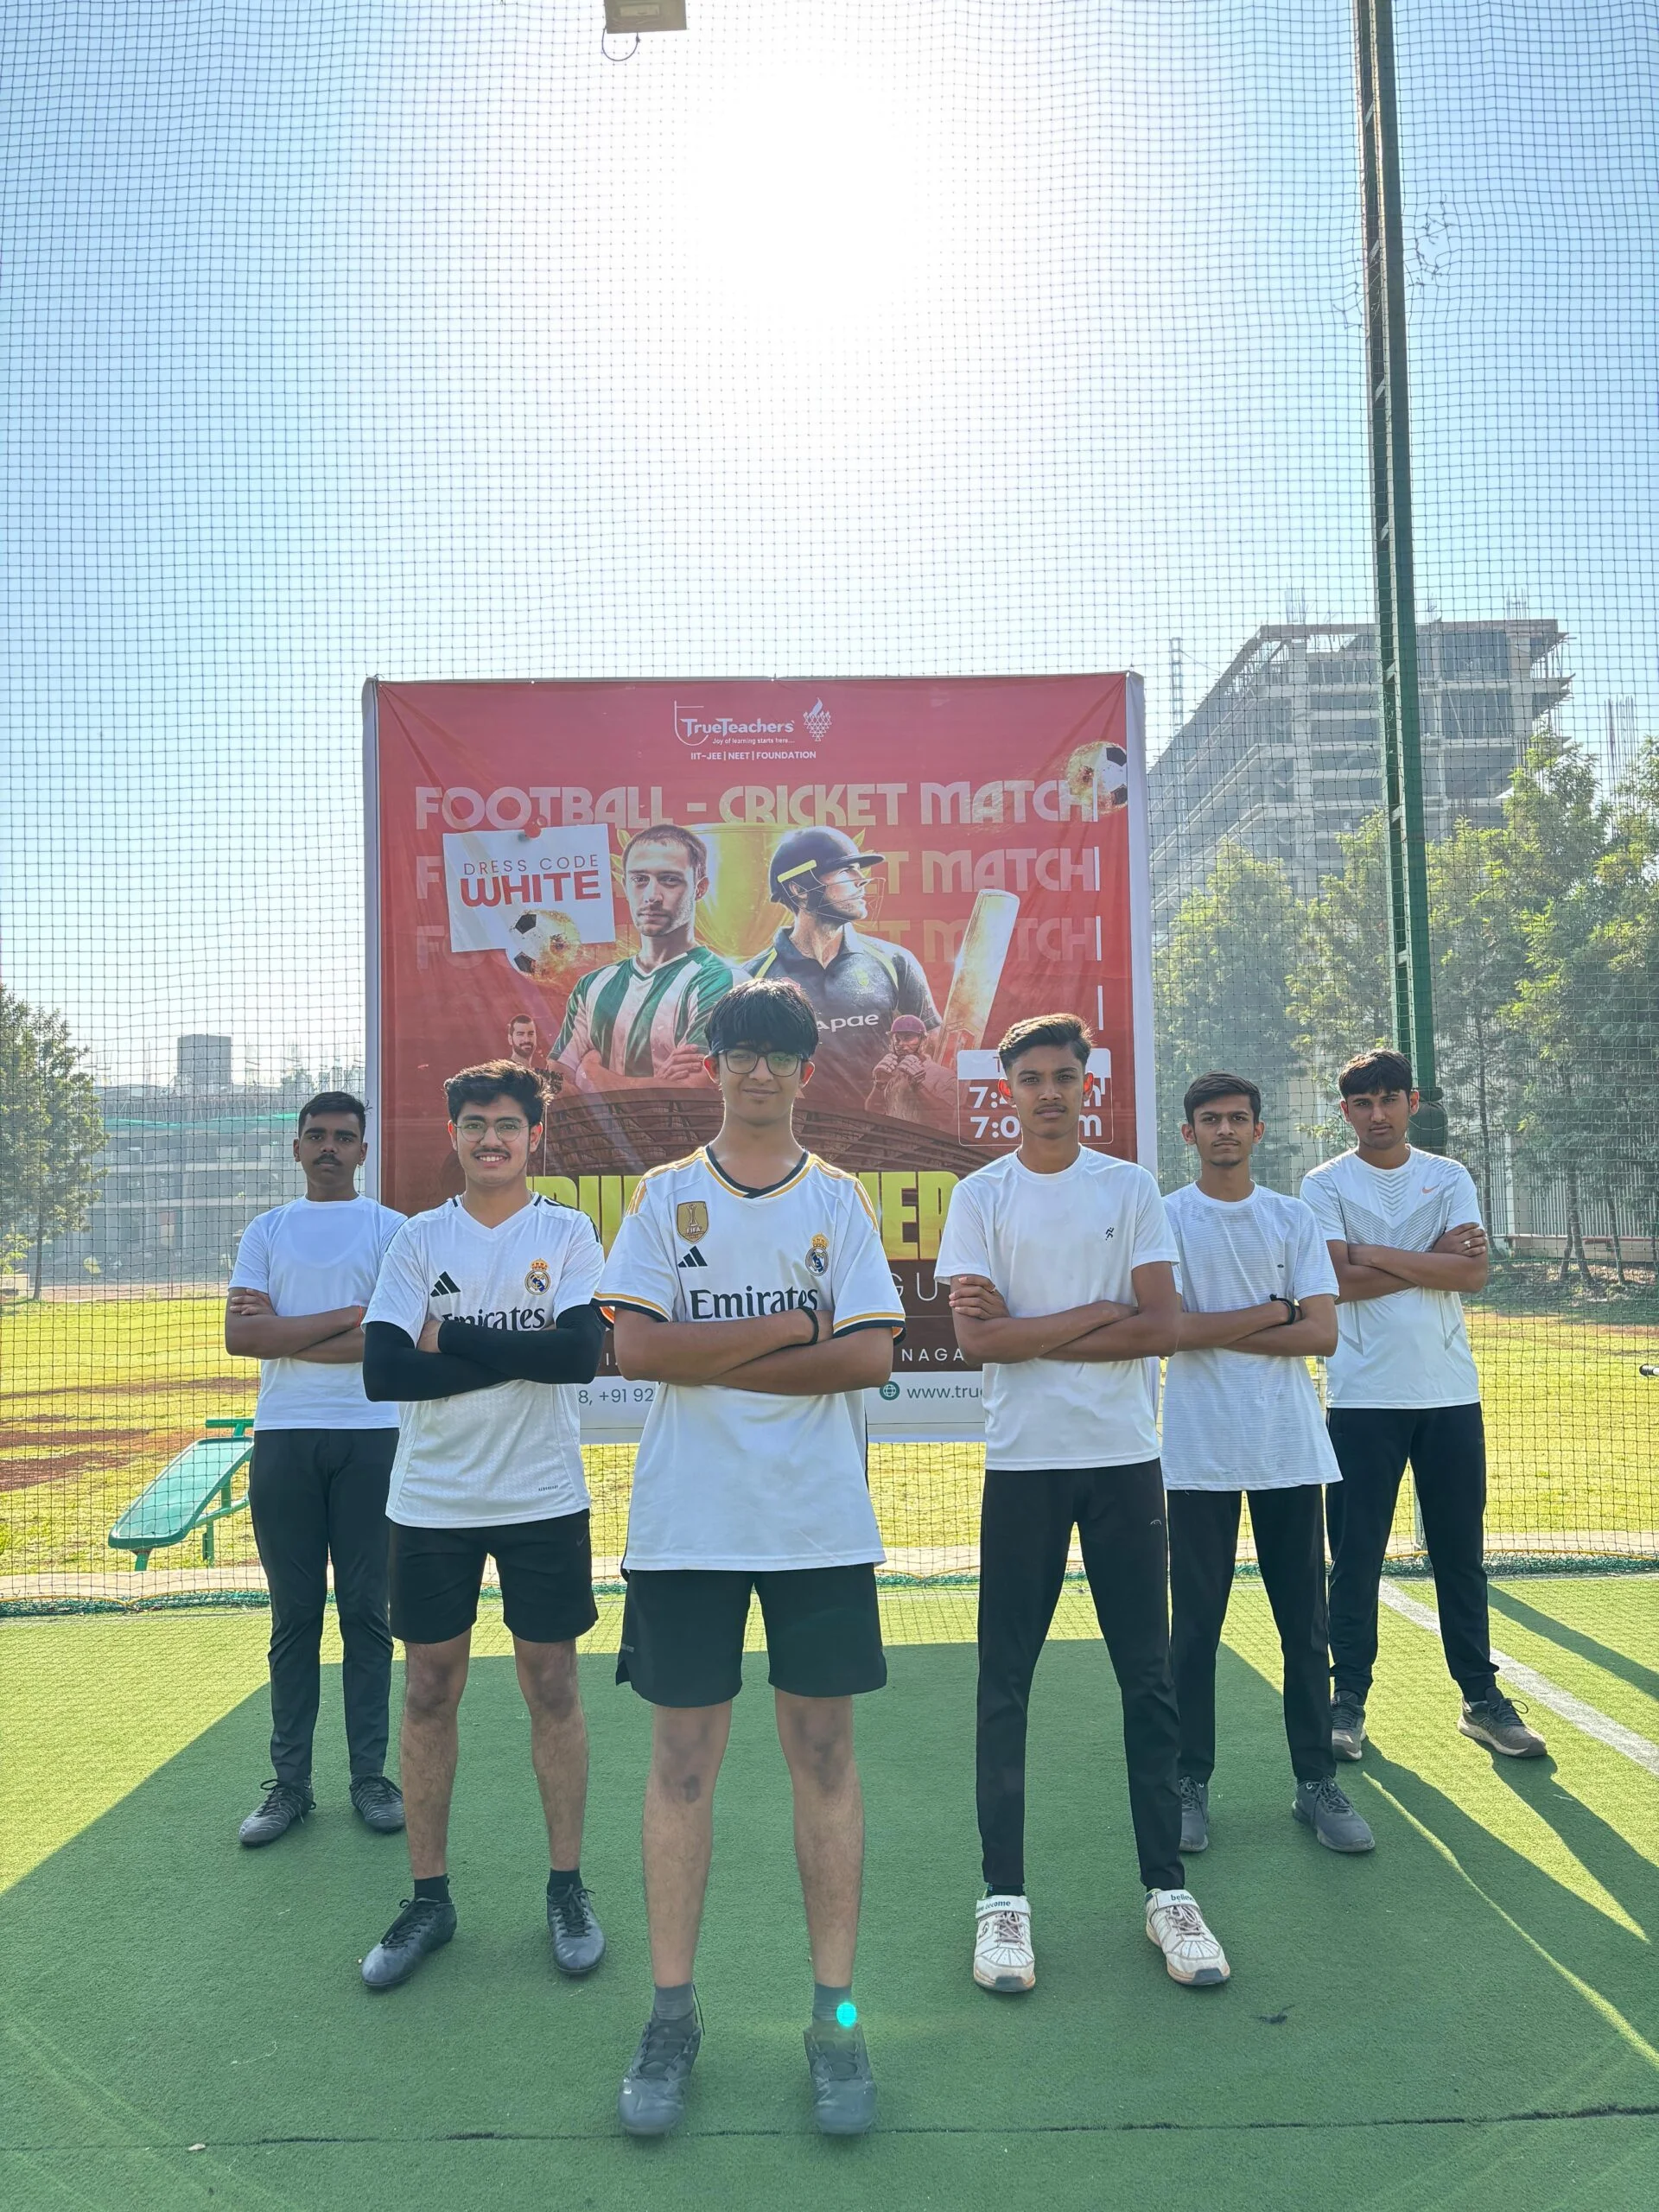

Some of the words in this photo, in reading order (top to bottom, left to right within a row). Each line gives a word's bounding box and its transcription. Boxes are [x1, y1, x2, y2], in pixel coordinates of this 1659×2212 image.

[756, 751, 817, 760] FOUNDATION
[416, 786, 673, 830] FOOTBALL
[719, 783, 907, 826] CRICKET
[464, 860, 527, 875] DRESS
[539, 855, 599, 871] CODE
[460, 870, 601, 907] WHITE
[689, 1285, 818, 1319] Emirates
[442, 1306, 545, 1332] irates
[599, 1389, 627, 1403] +91
[907, 1385, 982, 1399] www.tru
